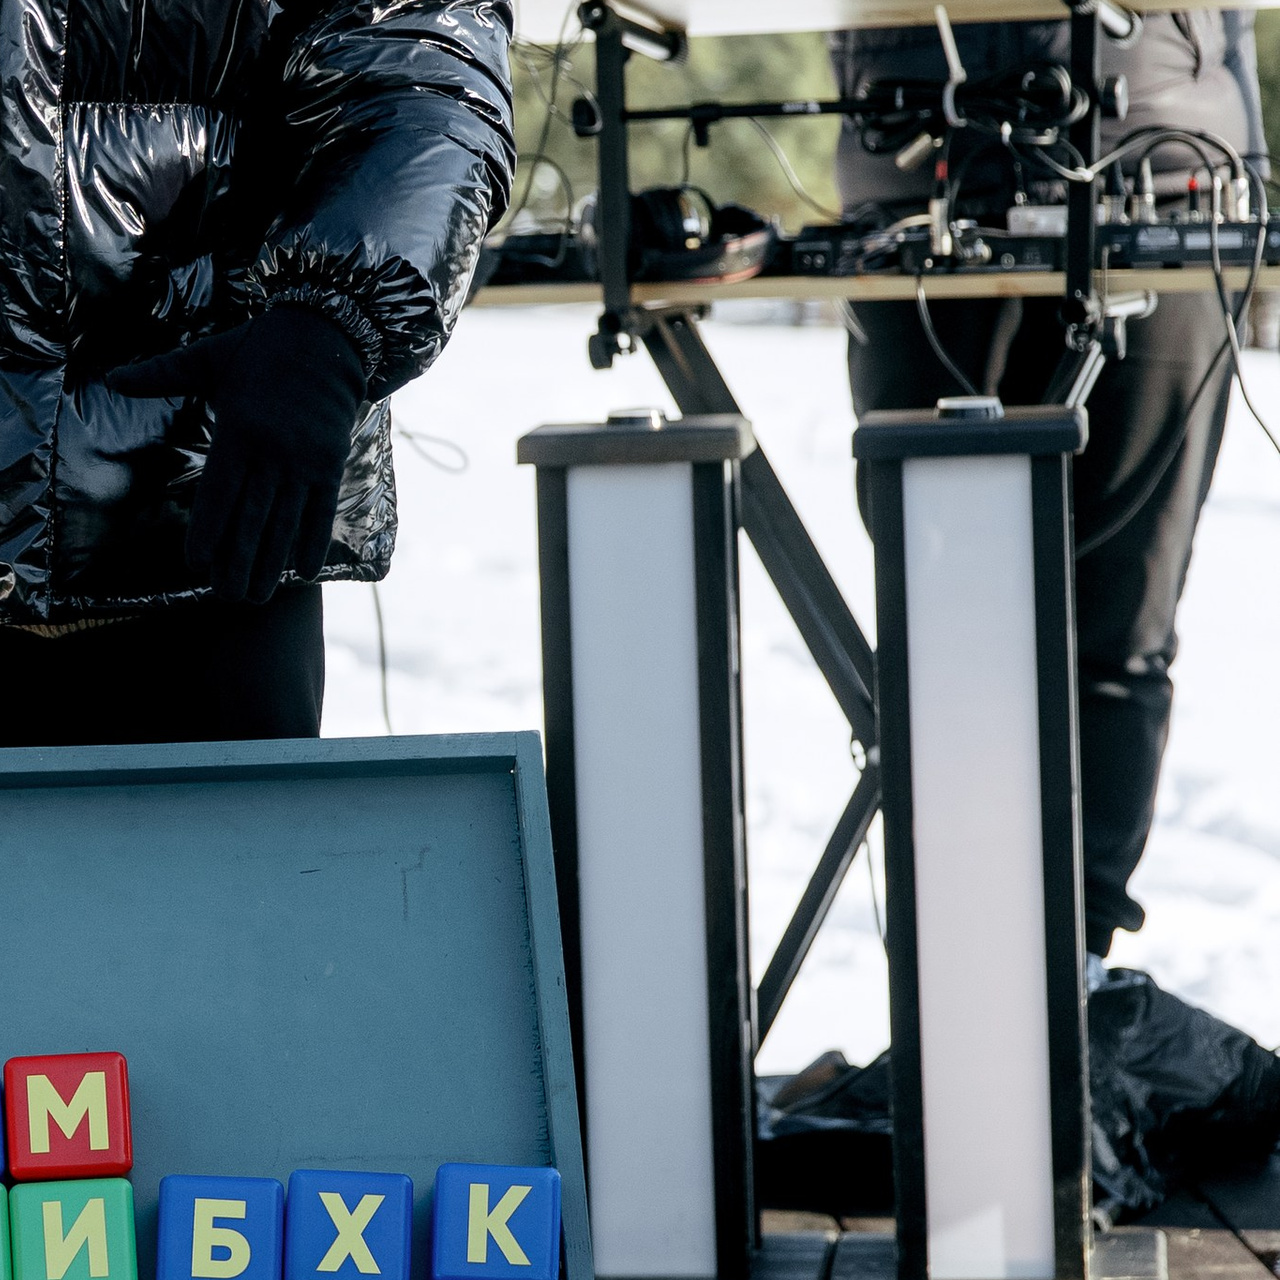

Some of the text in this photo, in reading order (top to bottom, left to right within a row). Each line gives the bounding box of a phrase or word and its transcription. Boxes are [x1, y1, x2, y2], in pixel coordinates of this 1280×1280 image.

[27, 1072, 109, 1154] М
[43, 1199, 109, 1280] И
[192, 1199, 250, 1279] Б
[317, 1193, 384, 1275] Х
[468, 1183, 531, 1265] К
